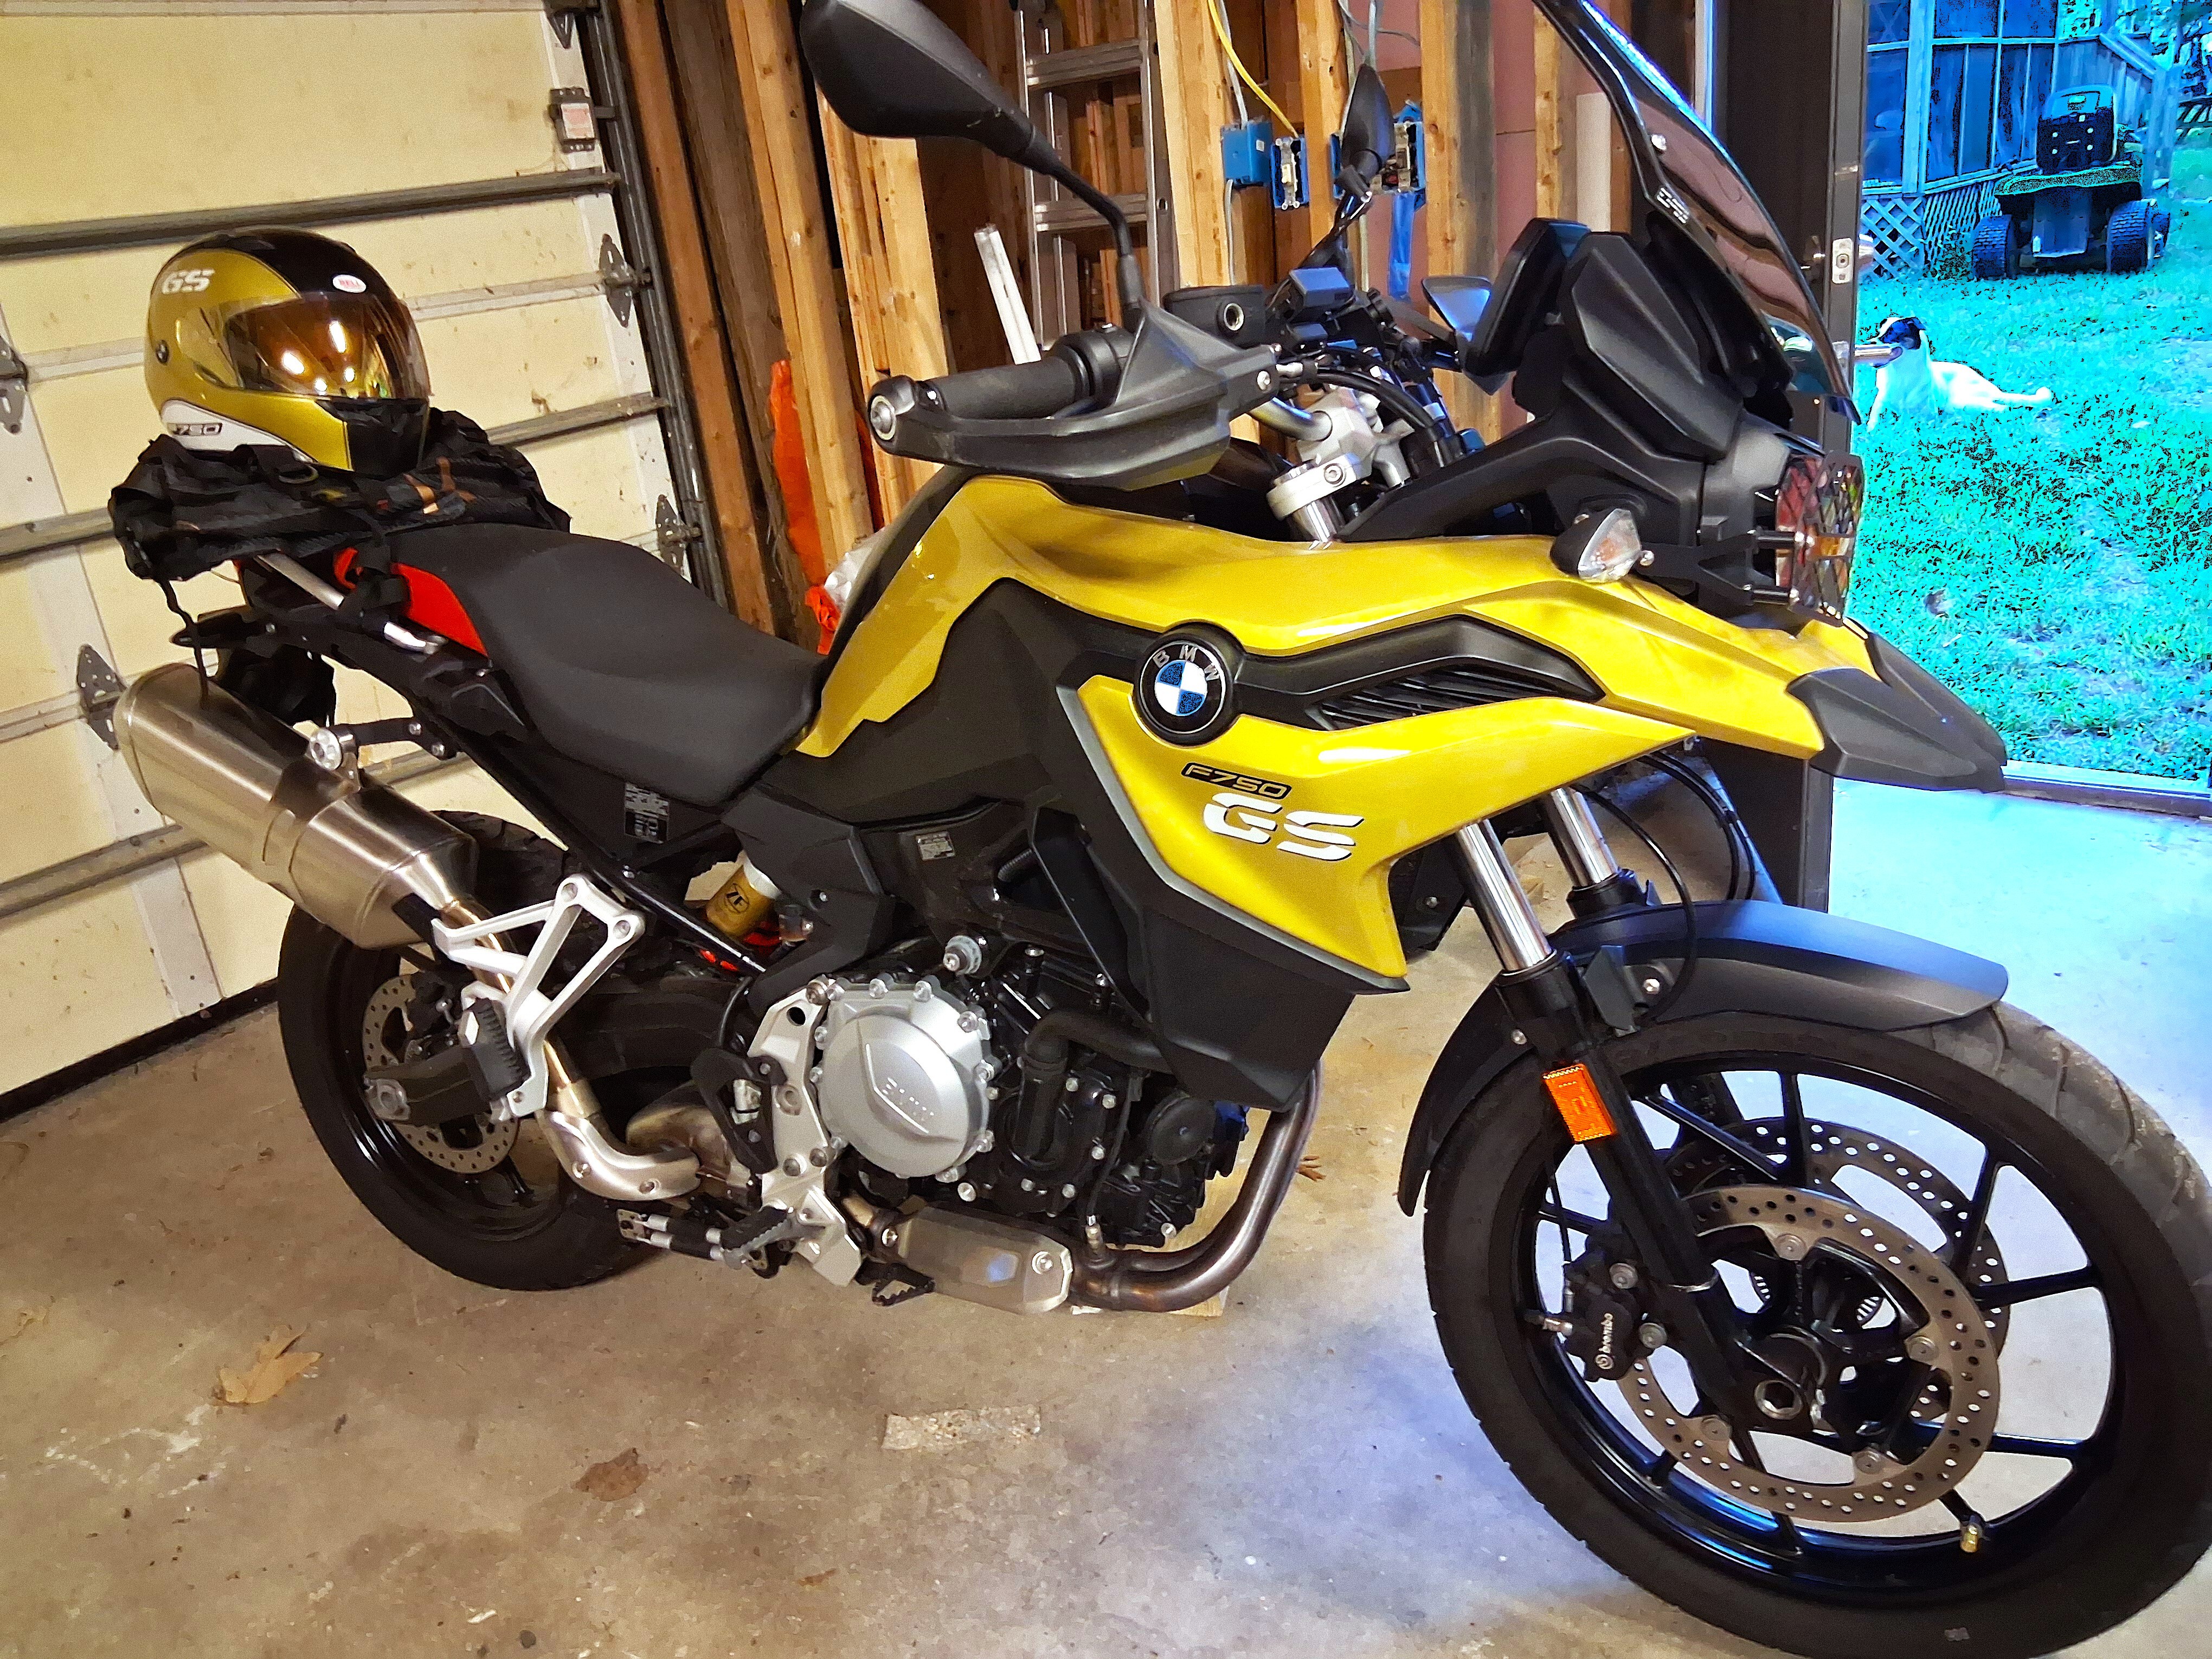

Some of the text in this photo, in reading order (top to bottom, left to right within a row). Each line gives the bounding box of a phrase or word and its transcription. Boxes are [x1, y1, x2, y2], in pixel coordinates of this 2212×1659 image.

[162, 269, 215, 294] GS
[1153, 645, 1220, 681] BMW
[1186, 765, 1288, 798] F750
[1204, 793, 1364, 861] GS
[1598, 1313, 1613, 1353] brembo
